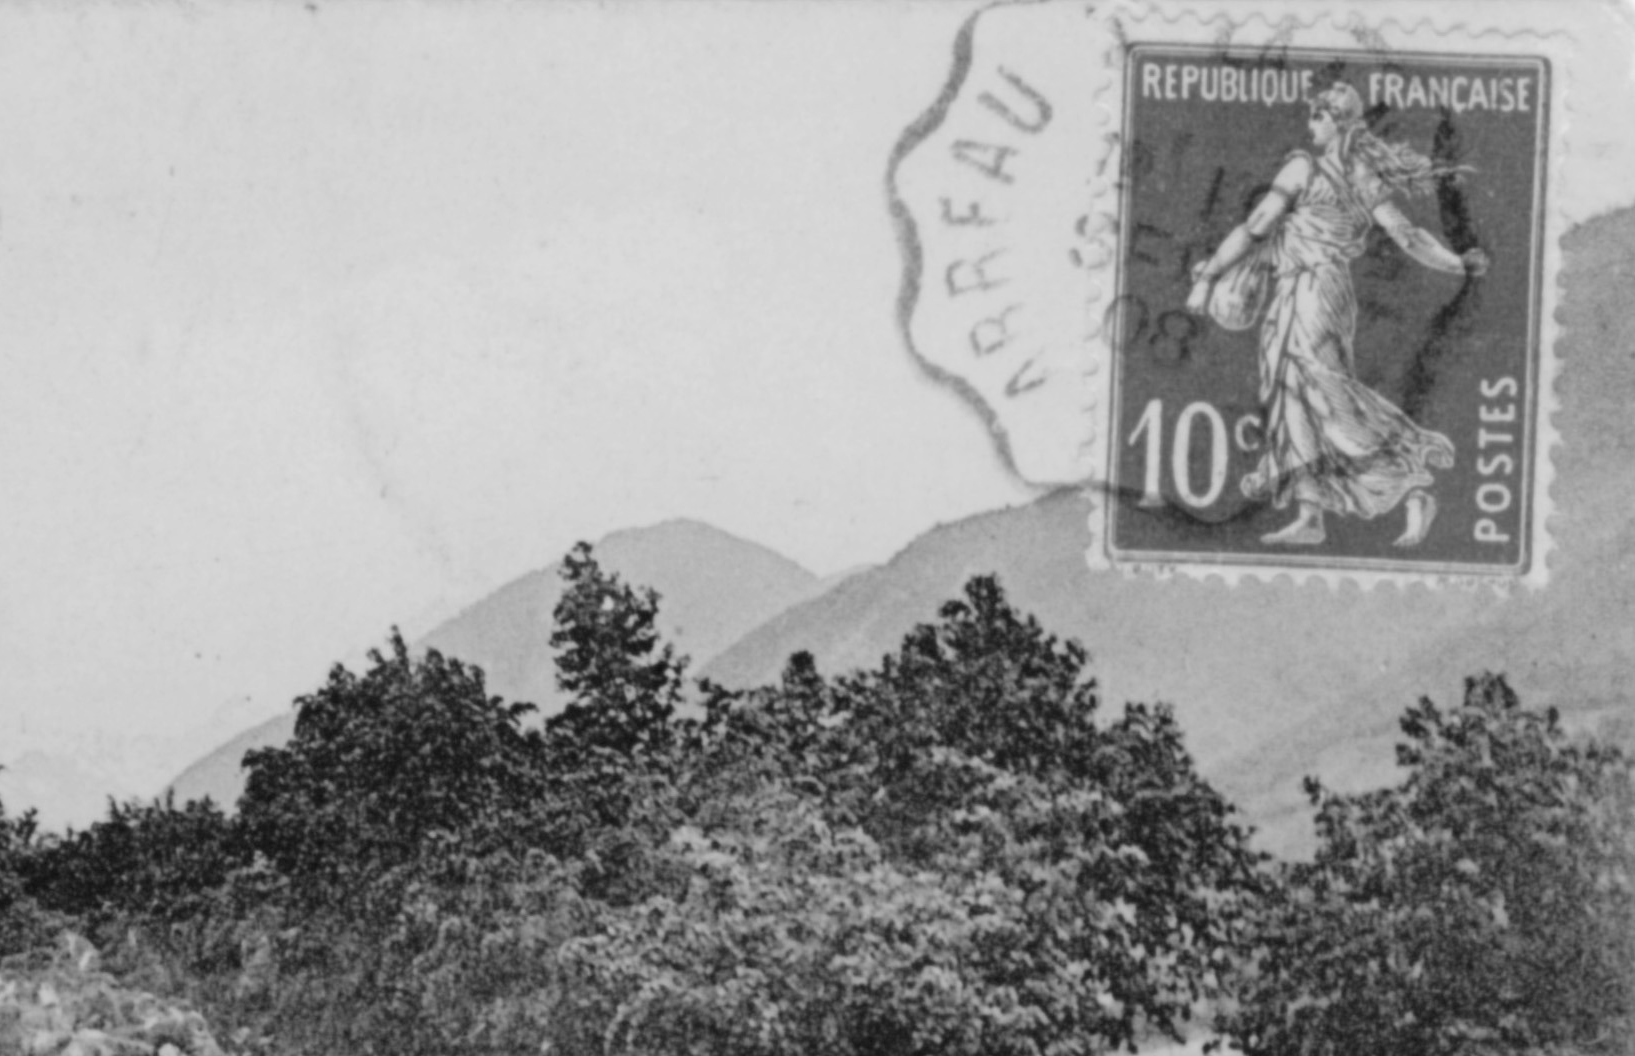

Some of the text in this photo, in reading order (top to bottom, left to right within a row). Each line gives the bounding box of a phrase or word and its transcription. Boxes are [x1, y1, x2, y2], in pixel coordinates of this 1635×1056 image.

[1141, 62, 1530, 113] REPUBLIQUE FRANÇAISE
[1474, 376, 1518, 543] POSTES
